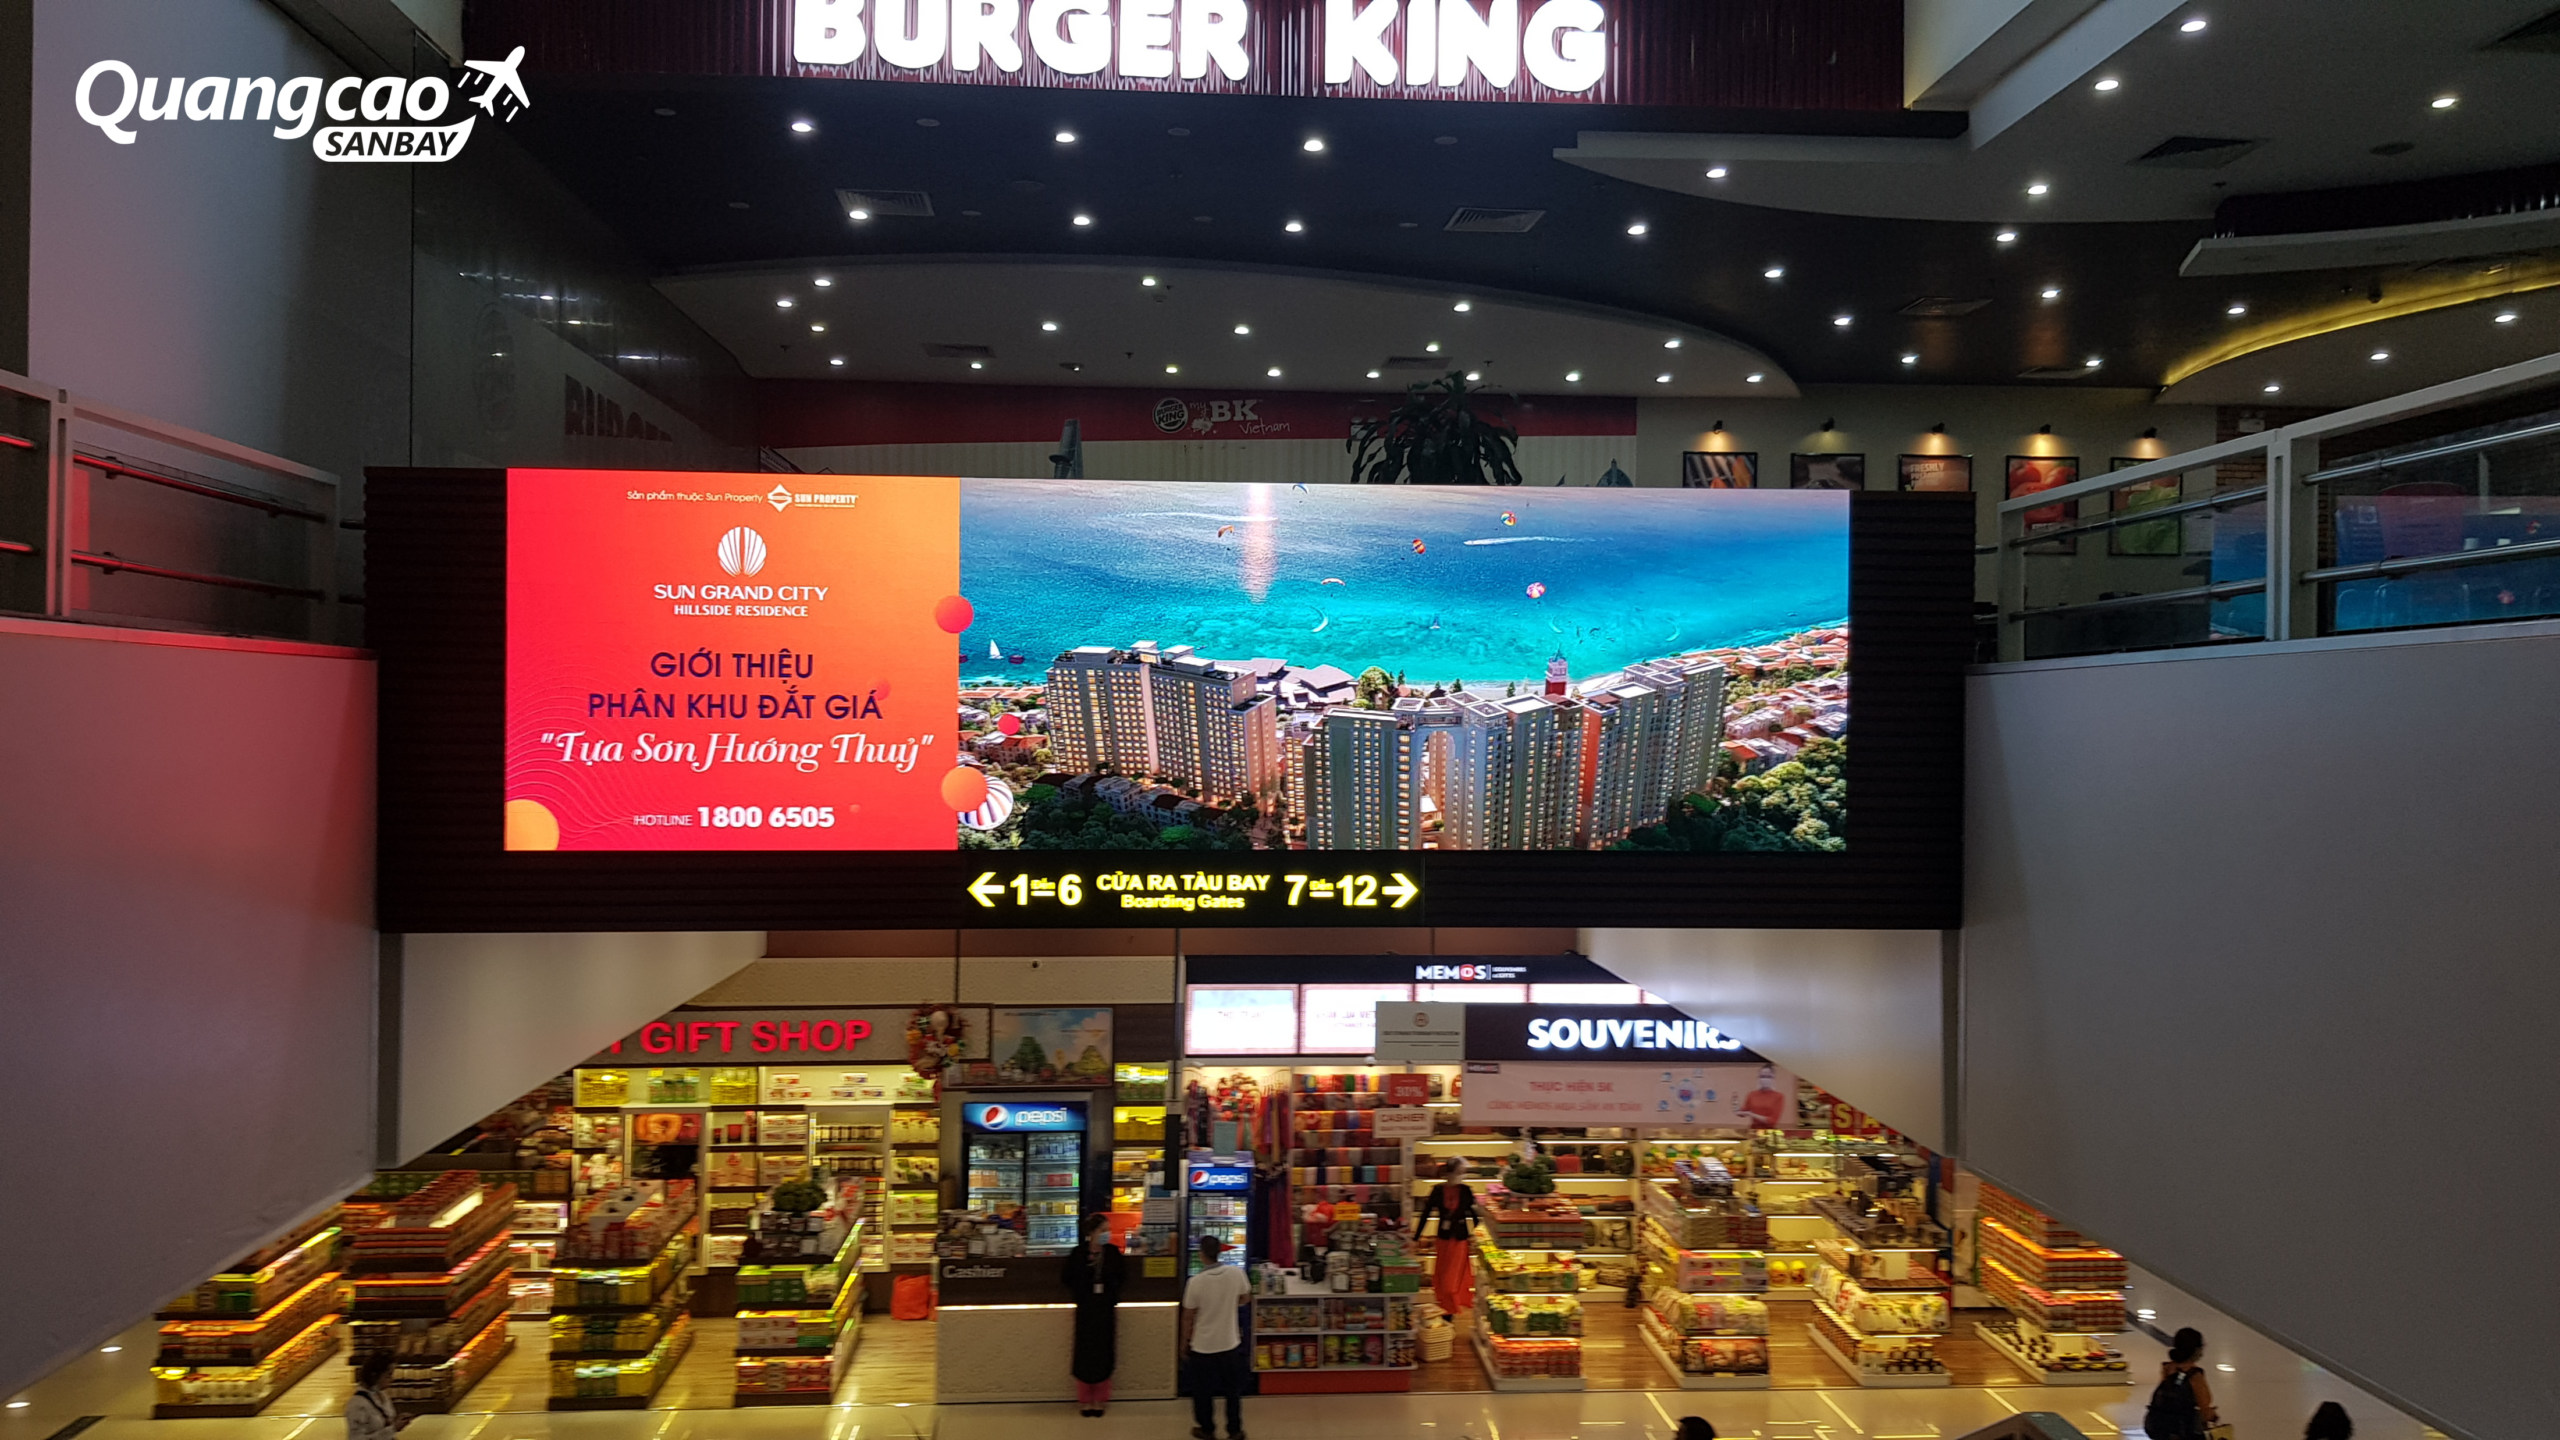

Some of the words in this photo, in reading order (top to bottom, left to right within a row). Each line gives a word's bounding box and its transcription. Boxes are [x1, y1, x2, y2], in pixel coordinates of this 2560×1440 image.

[793, 0, 1249, 80] BURGER
[1325, 0, 1606, 92] KING
[1158, 410, 1185, 425] KING
[1210, 400, 1258, 421] BK
[1239, 418, 1291, 435] Vietnam
[646, 490, 674, 502] phẩm
[677, 491, 703, 503] thuộc
[706, 493, 722, 501] Sun
[725, 493, 763, 504] Property
[795, 494, 811, 503] SUN
[814, 494, 856, 504] PROPERTY
[653, 584, 695, 599] SUN
[700, 584, 774, 600] GRAND
[778, 586, 829, 601] CITY
[674, 604, 732, 615] HILLSIDE
[735, 605, 809, 617] RESIDENCE
[651, 647, 721, 677] GIỚI
[732, 649, 813, 684] THIỆU
[588, 688, 675, 718] PHÂN
[687, 694, 747, 719] KHU
[758, 685, 814, 719] ĐẮT
[825, 690, 884, 720] GIÁ
[631, 732, 699, 764] Sơn
[692, 733, 823, 773] Hướng
[633, 814, 693, 826] HOTLINE
[697, 806, 763, 828] 1800
[768, 806, 835, 828] 6505
[1010, 873, 1028, 905] 1
[1057, 873, 1082, 906] 6
[1096, 871, 1144, 890] CỬA
[1147, 874, 1178, 890] RA
[1180, 871, 1223, 890] TÀU
[1227, 874, 1271, 890] BAY
[1284, 874, 1308, 905] 7
[1336, 874, 1377, 906] 12
[1121, 894, 1195, 911] Boarding
[1197, 894, 1245, 908] Gates
[1415, 964, 1487, 980] MEMOS
[640, 1021, 741, 1054] GIFT
[751, 1019, 872, 1053] SHOP
[1015, 1107, 1068, 1126] pepsi
